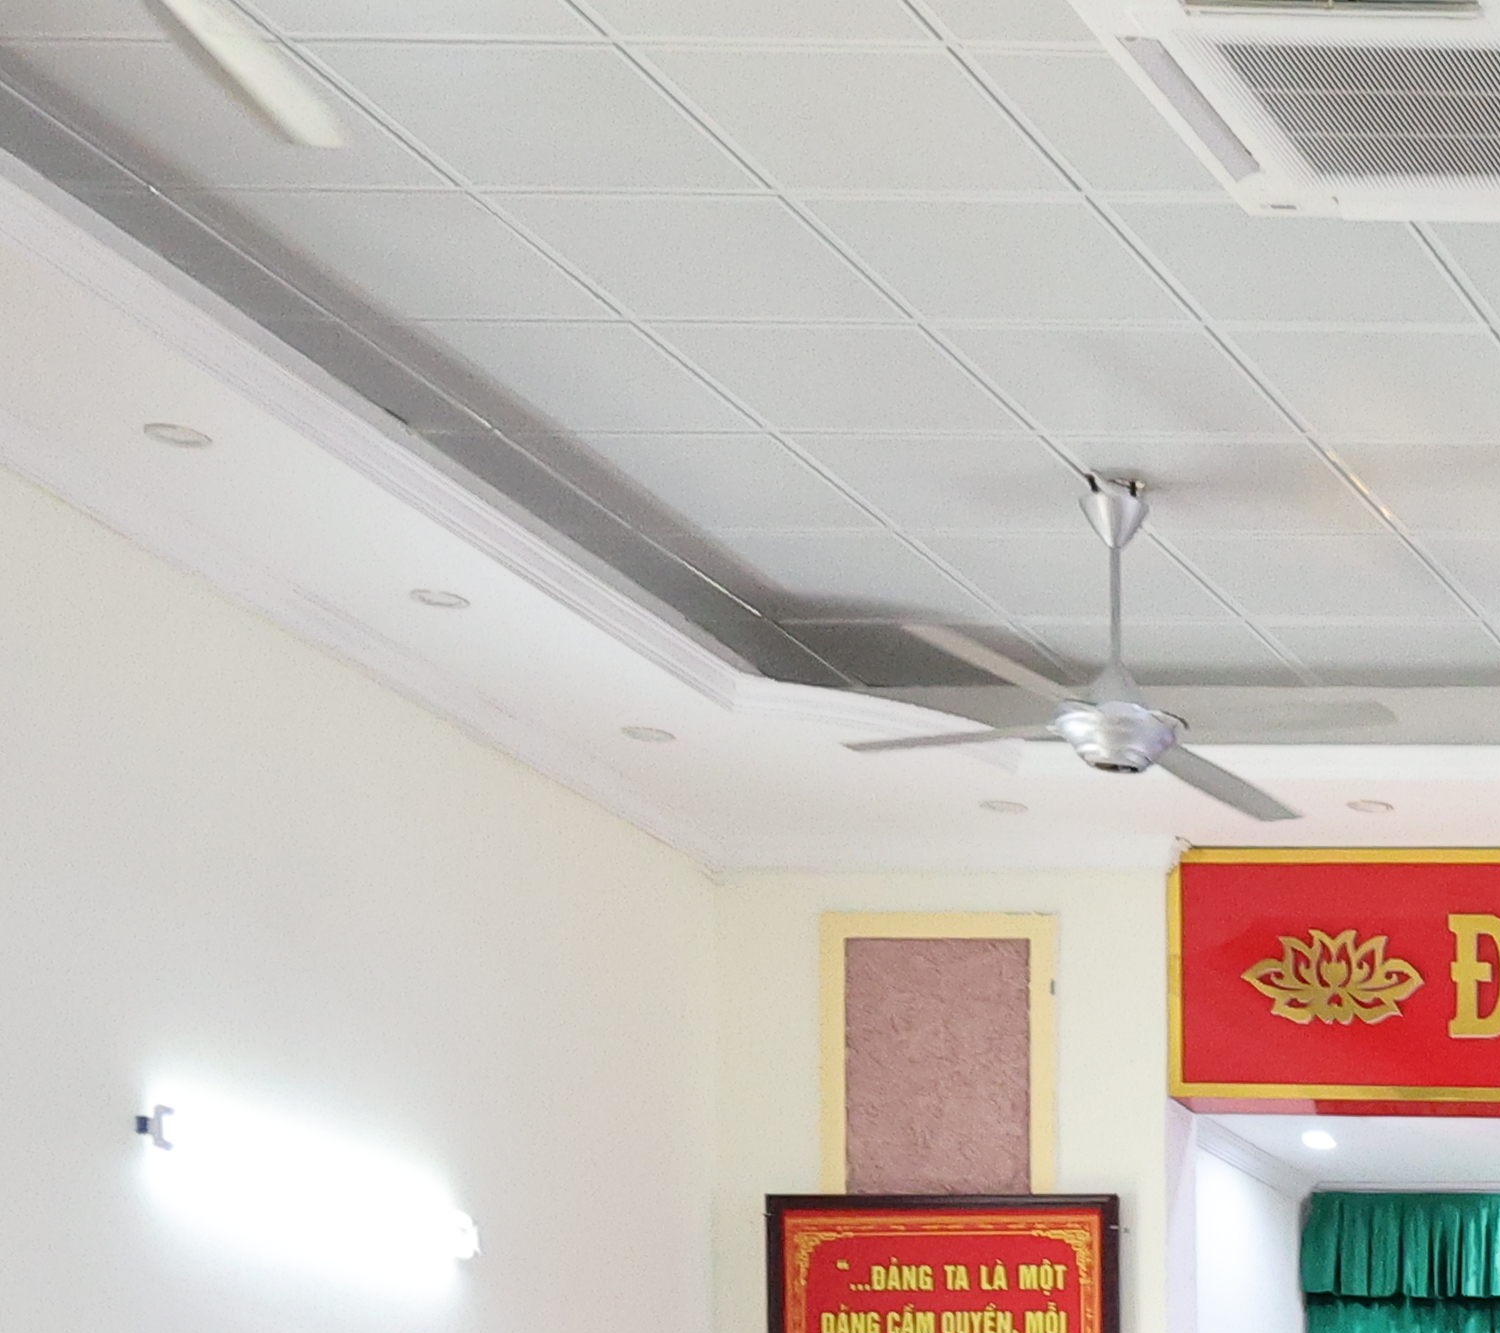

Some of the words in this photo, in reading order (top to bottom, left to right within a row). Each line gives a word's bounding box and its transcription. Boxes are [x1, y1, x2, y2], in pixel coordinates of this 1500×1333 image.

[943, 1265, 970, 1290] TA
[979, 1259, 1009, 1290] LÀ
[1018, 1259, 1068, 1295] MỘT
